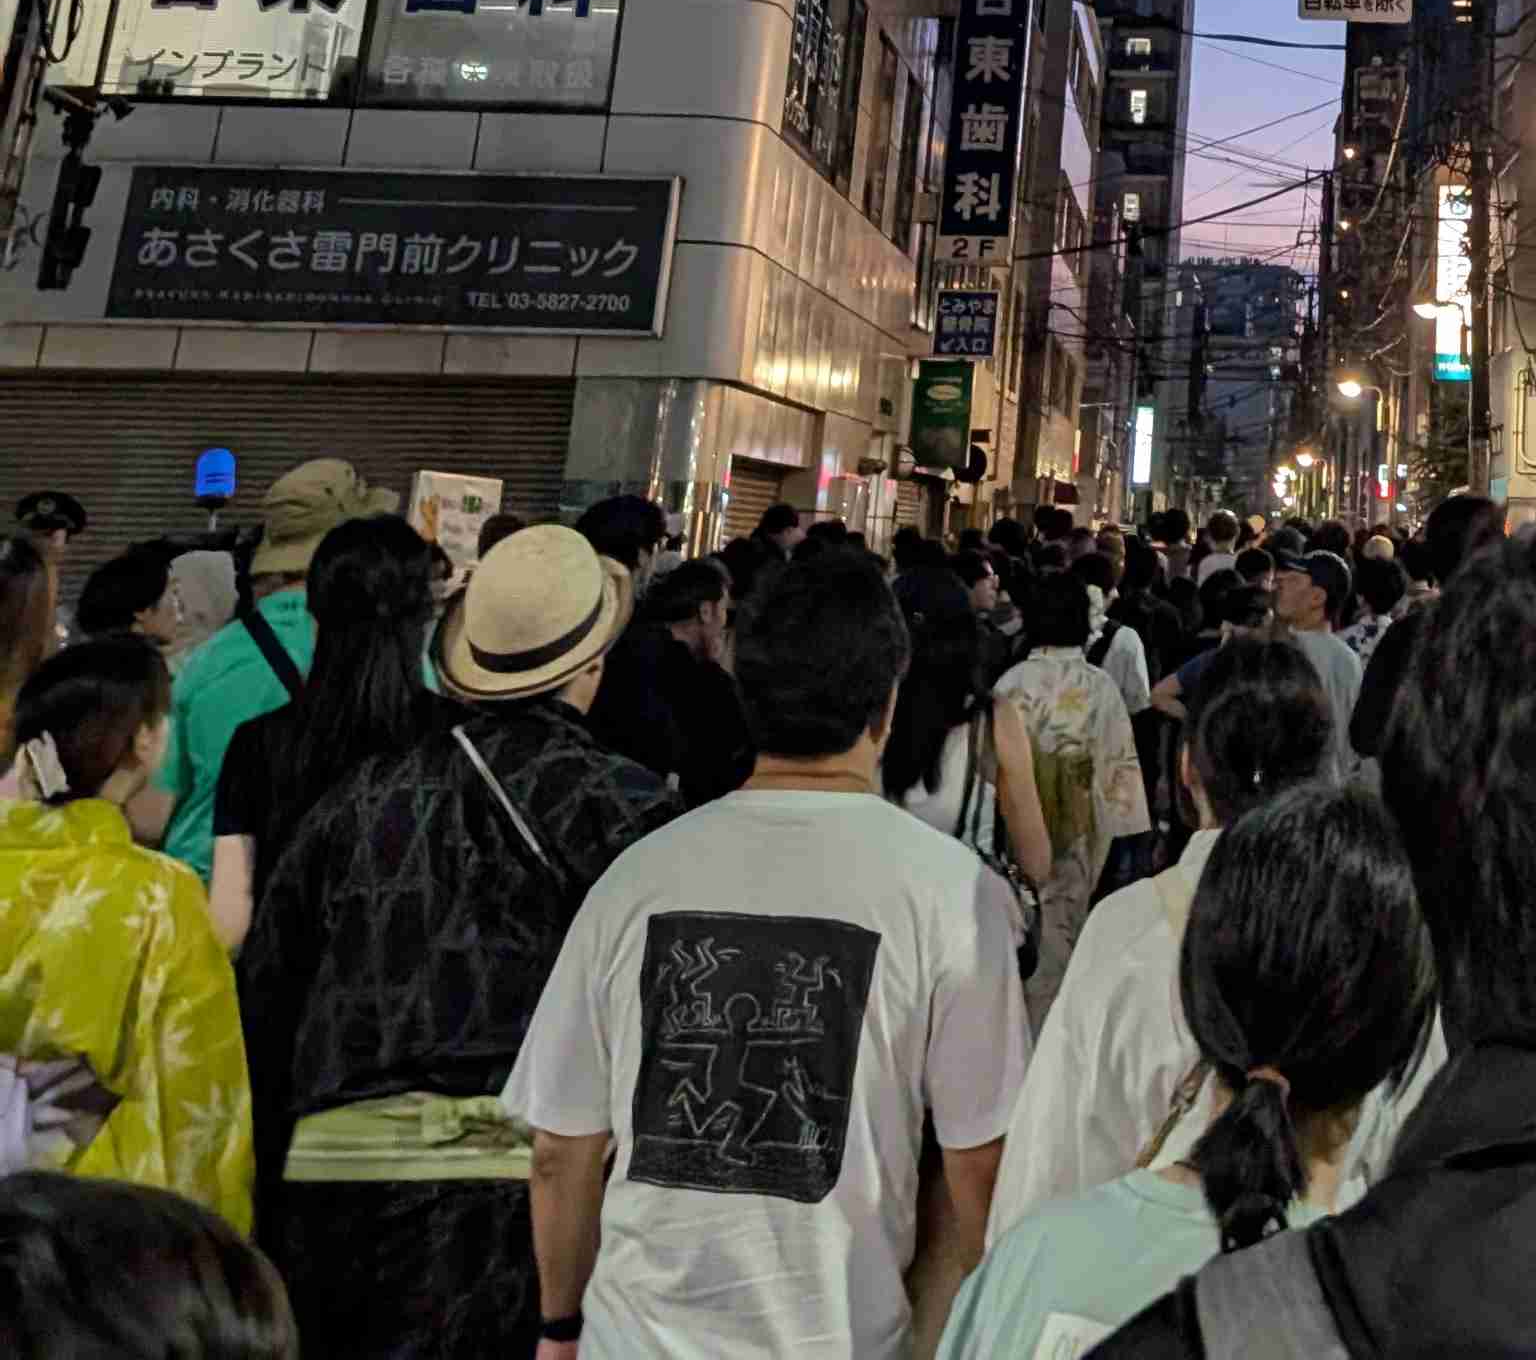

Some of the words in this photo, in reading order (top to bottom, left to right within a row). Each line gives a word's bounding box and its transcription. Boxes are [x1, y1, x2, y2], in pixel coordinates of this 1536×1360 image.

[126, 48, 325, 82] インプラント
[137, 227, 639, 276] あさくさ雷門前クリニック
